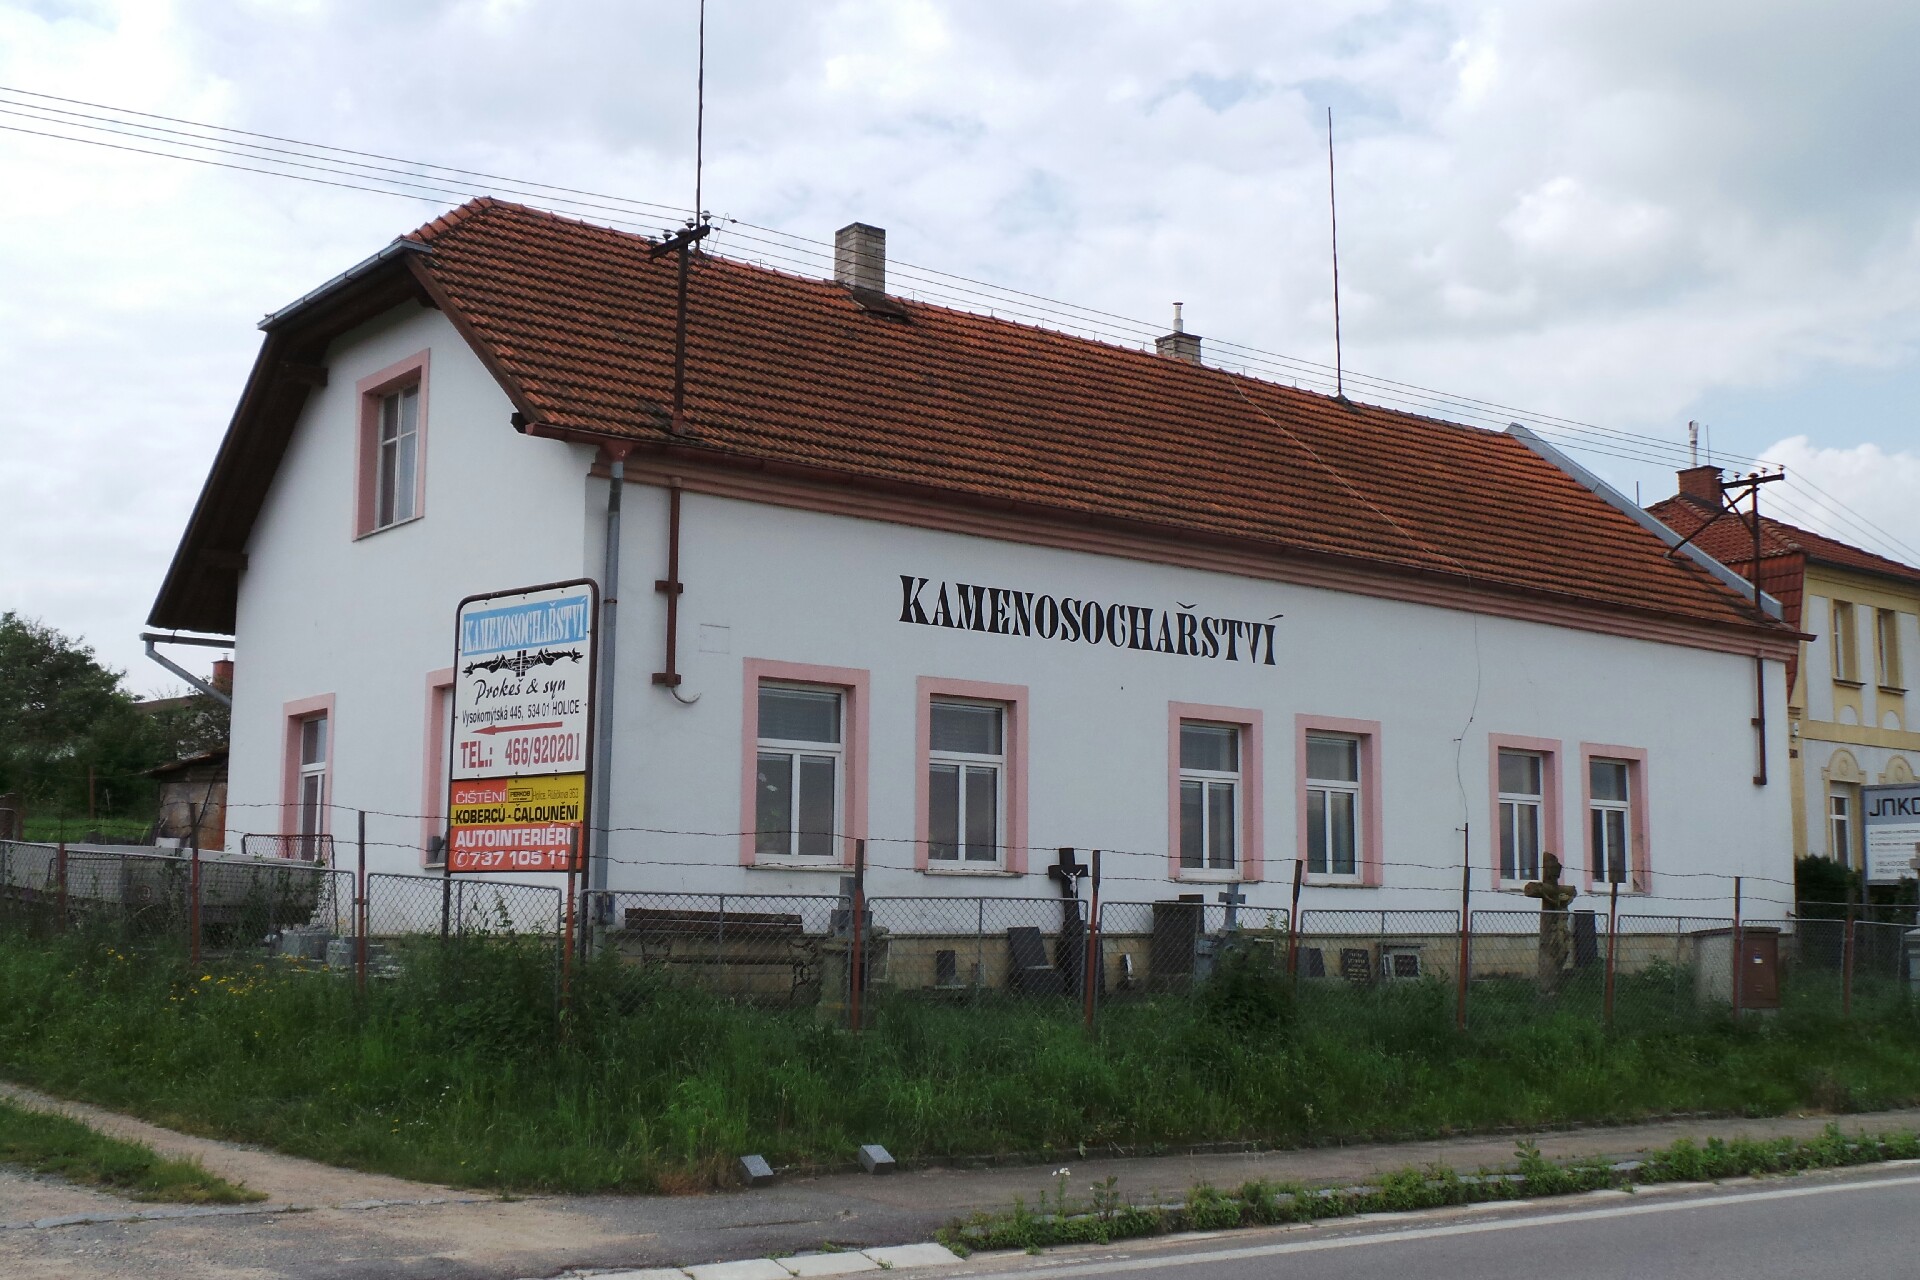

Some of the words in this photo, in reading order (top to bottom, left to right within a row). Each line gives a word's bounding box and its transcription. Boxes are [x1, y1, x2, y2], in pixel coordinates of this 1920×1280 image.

[464, 596, 588, 650] KAMENOSOCHAŘSTVÍ
[899, 574, 1284, 666] KAMENOSOCHAŘSTVÍ
[473, 677, 523, 705] Prokeš
[526, 679, 538, 694] &
[543, 679, 566, 700] syn
[462, 705, 508, 727] Vysokomýtská
[527, 703, 540, 719] 534
[541, 703, 550, 717] 01
[551, 699, 580, 716] HOLICE
[460, 741, 492, 768] TEL.:
[504, 732, 580, 768] 466/920201
[455, 788, 507, 804] ČIŠTĚNÍ
[455, 803, 506, 824] KOBERCŮ
[513, 801, 579, 822] ČALOUNĚNÍ
[470, 850, 504, 866] 737
[509, 849, 542, 865] 105
[548, 849, 570, 865] 11
